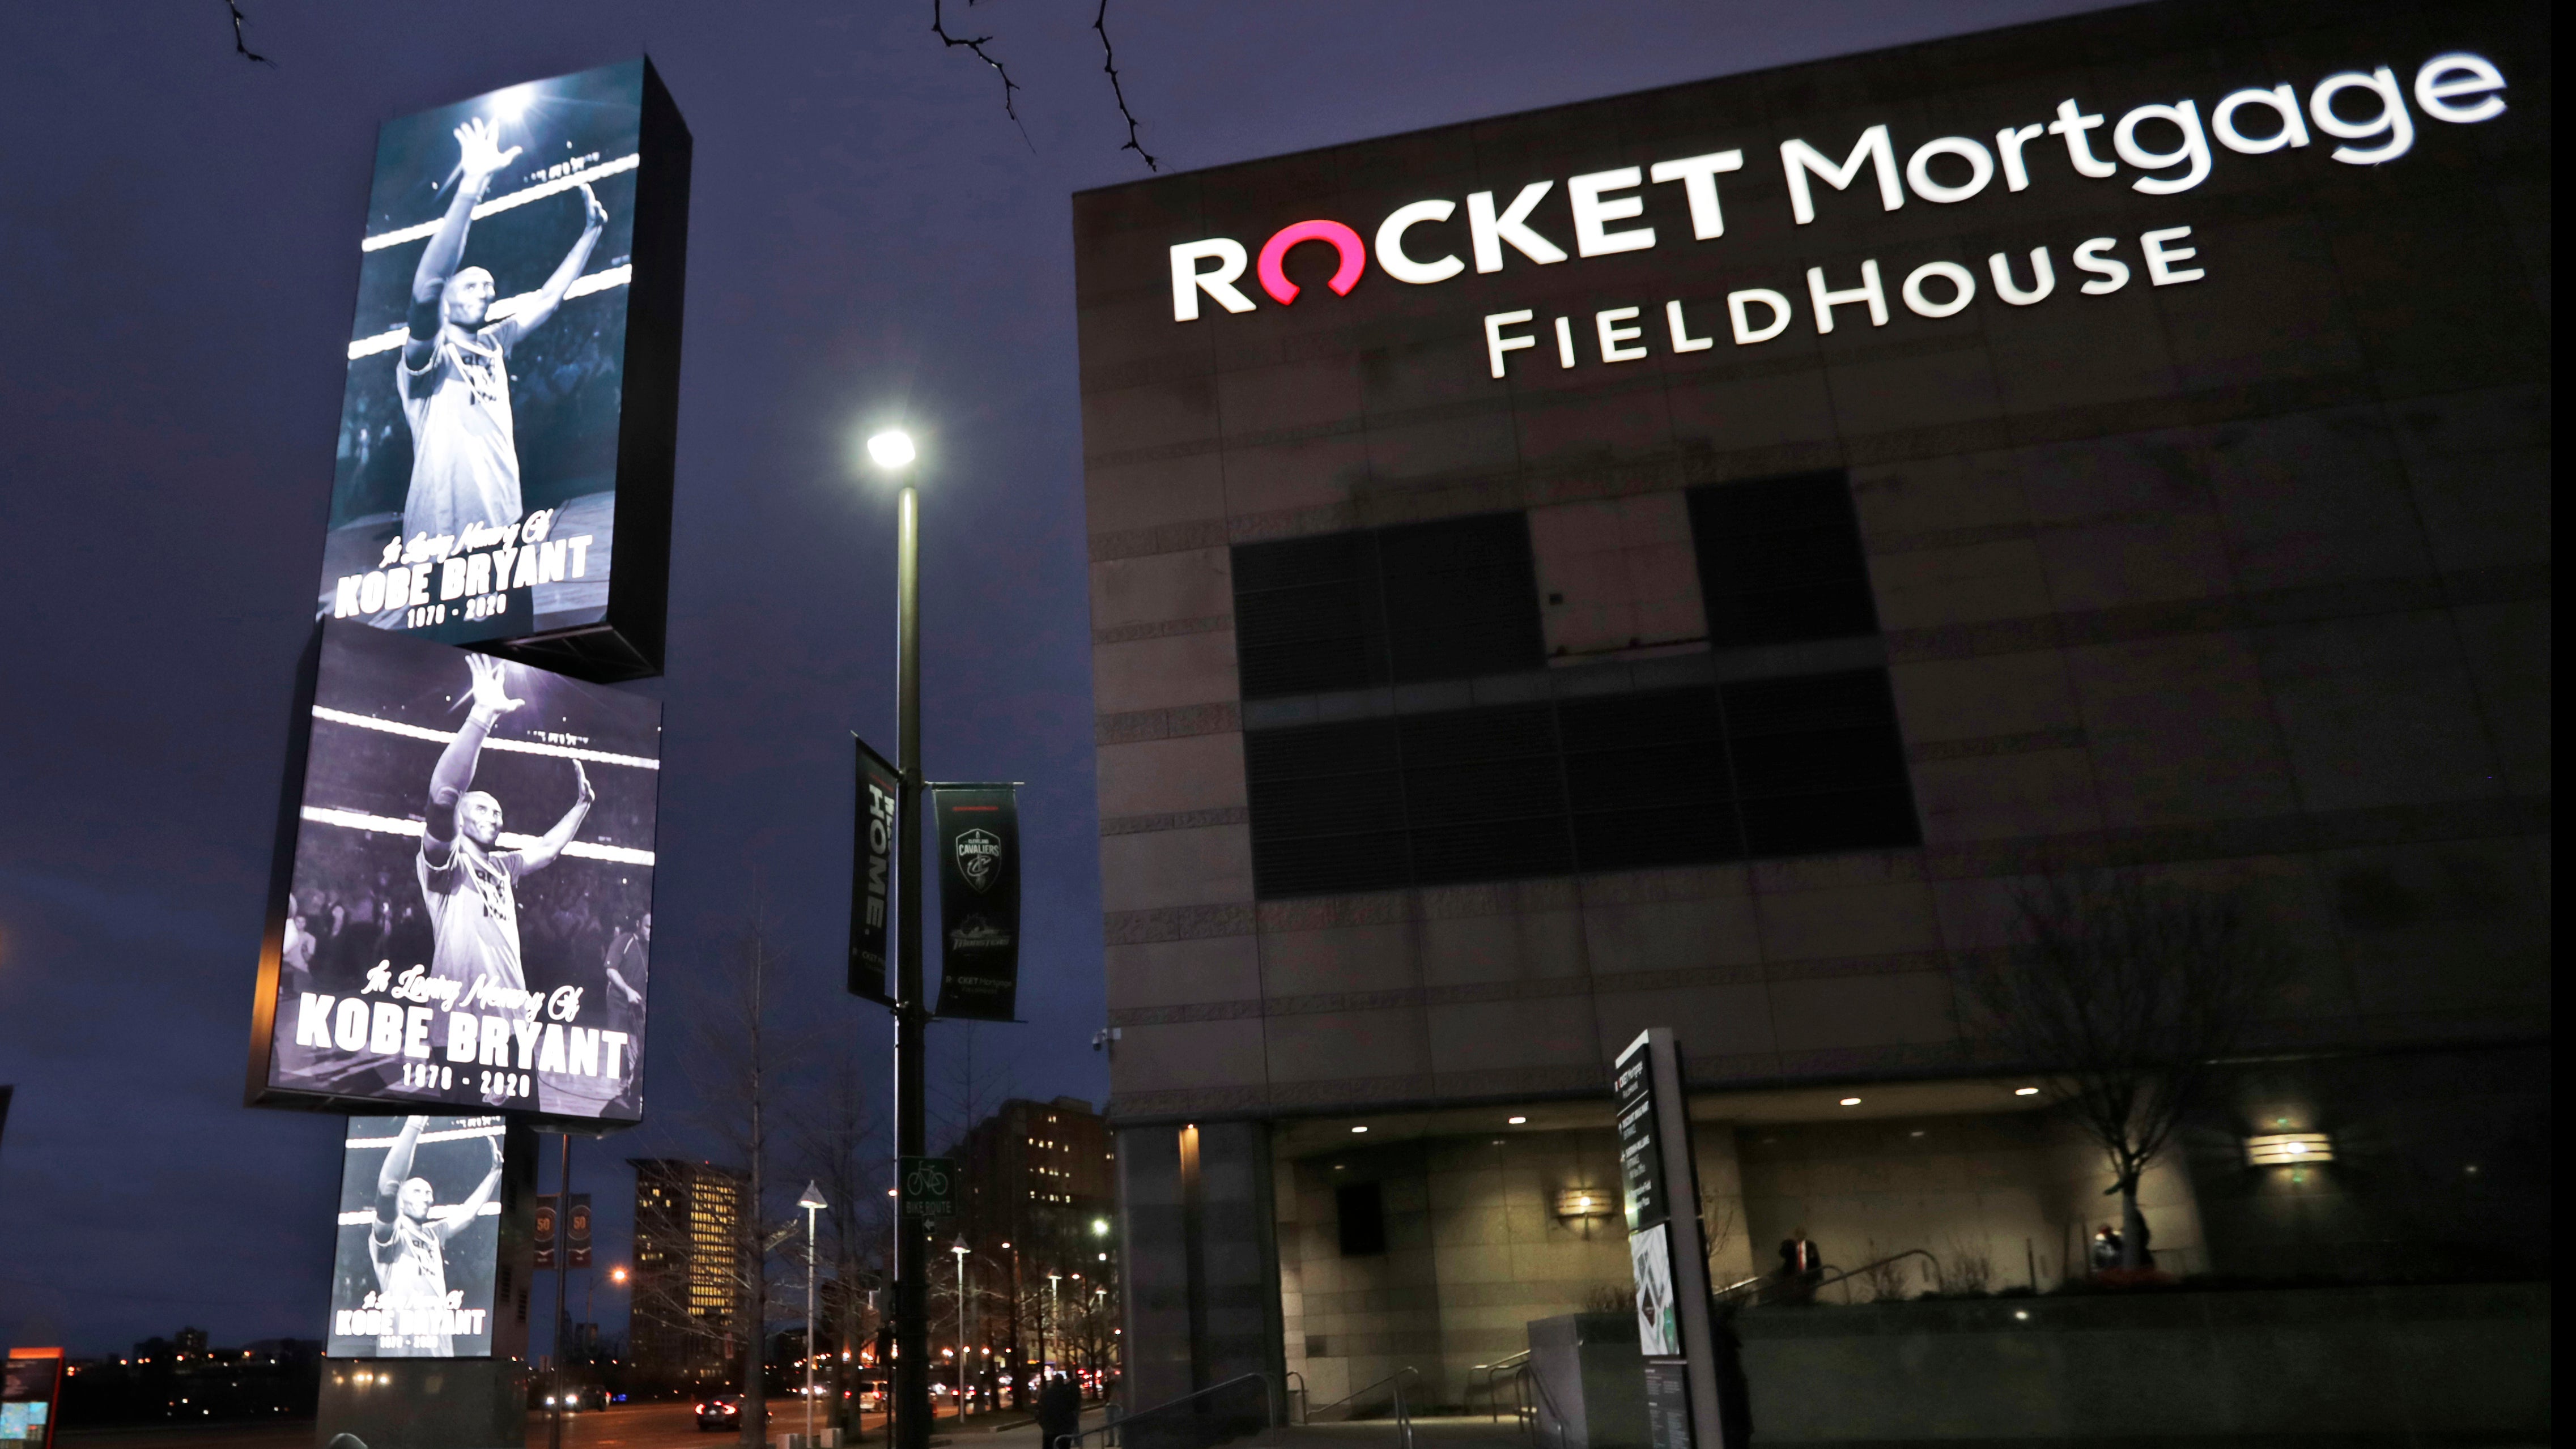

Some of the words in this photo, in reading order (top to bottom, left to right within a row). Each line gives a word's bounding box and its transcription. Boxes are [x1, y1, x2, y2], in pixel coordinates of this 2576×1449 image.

[1169, 148, 1745, 322] ROCKET
[1779, 51, 2510, 225] Mortgage
[1483, 225, 2206, 379] FIELDHOUSE
[334, 562, 433, 619] KOBE
[440, 534, 593, 601] BRYANT
[465, 594, 507, 620] 2020
[958, 844, 1000, 856] CAVALIERS
[361, 959, 392, 995] In
[391, 964, 463, 1013] Loving
[459, 973, 545, 1022] Memory
[547, 985, 584, 1022] Of
[295, 992, 433, 1059] KOBE
[446, 1011, 628, 1080] BRYANT
[480, 1070, 530, 1098] 2020
[906, 1200, 924, 1214] BIKE
[925, 1200, 951, 1214] ROUTE
[537, 1217, 551, 1231] 50
[573, 1216, 586, 1230] 50
[335, 1310, 395, 1335] KOBE
[398, 1309, 486, 1335] BRYANT
